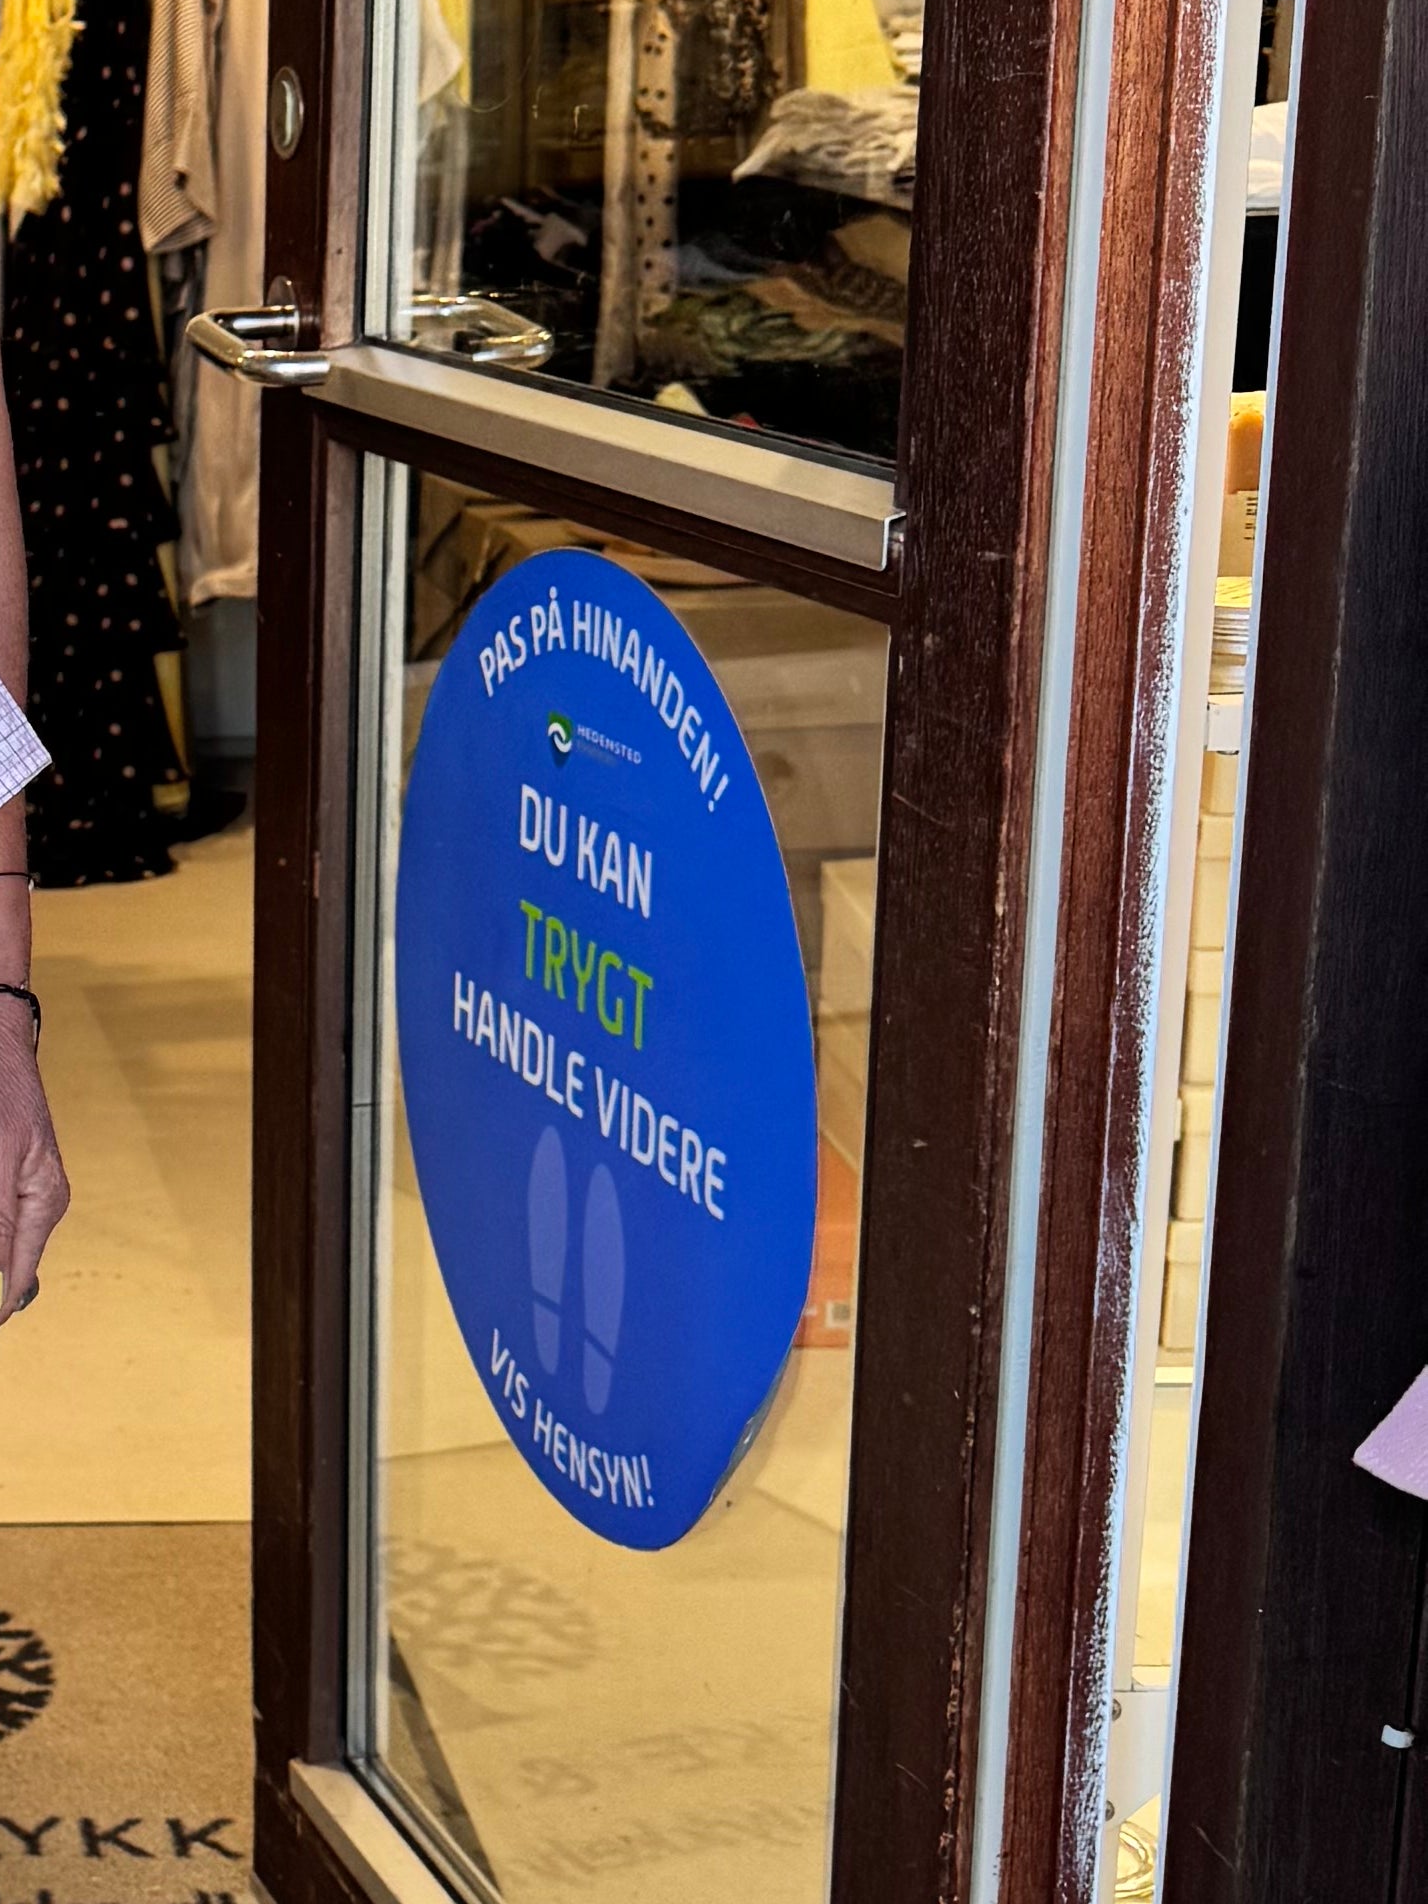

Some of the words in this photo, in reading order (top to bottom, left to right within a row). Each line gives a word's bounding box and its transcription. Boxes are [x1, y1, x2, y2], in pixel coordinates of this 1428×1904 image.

[479, 614, 528, 698] PAS
[530, 585, 567, 657] PÅ
[572, 599, 731, 813] HINANDEN!
[577, 723, 643, 765] HEDENSTED
[519, 782, 568, 868] DU
[577, 814, 653, 920] KAN
[519, 898, 654, 1051] TRYGT
[453, 969, 586, 1120] HANDLE
[594, 1064, 727, 1221] VIDERE
[491, 1327, 530, 1420] VIS
[533, 1397, 656, 1508] HENSYN!
